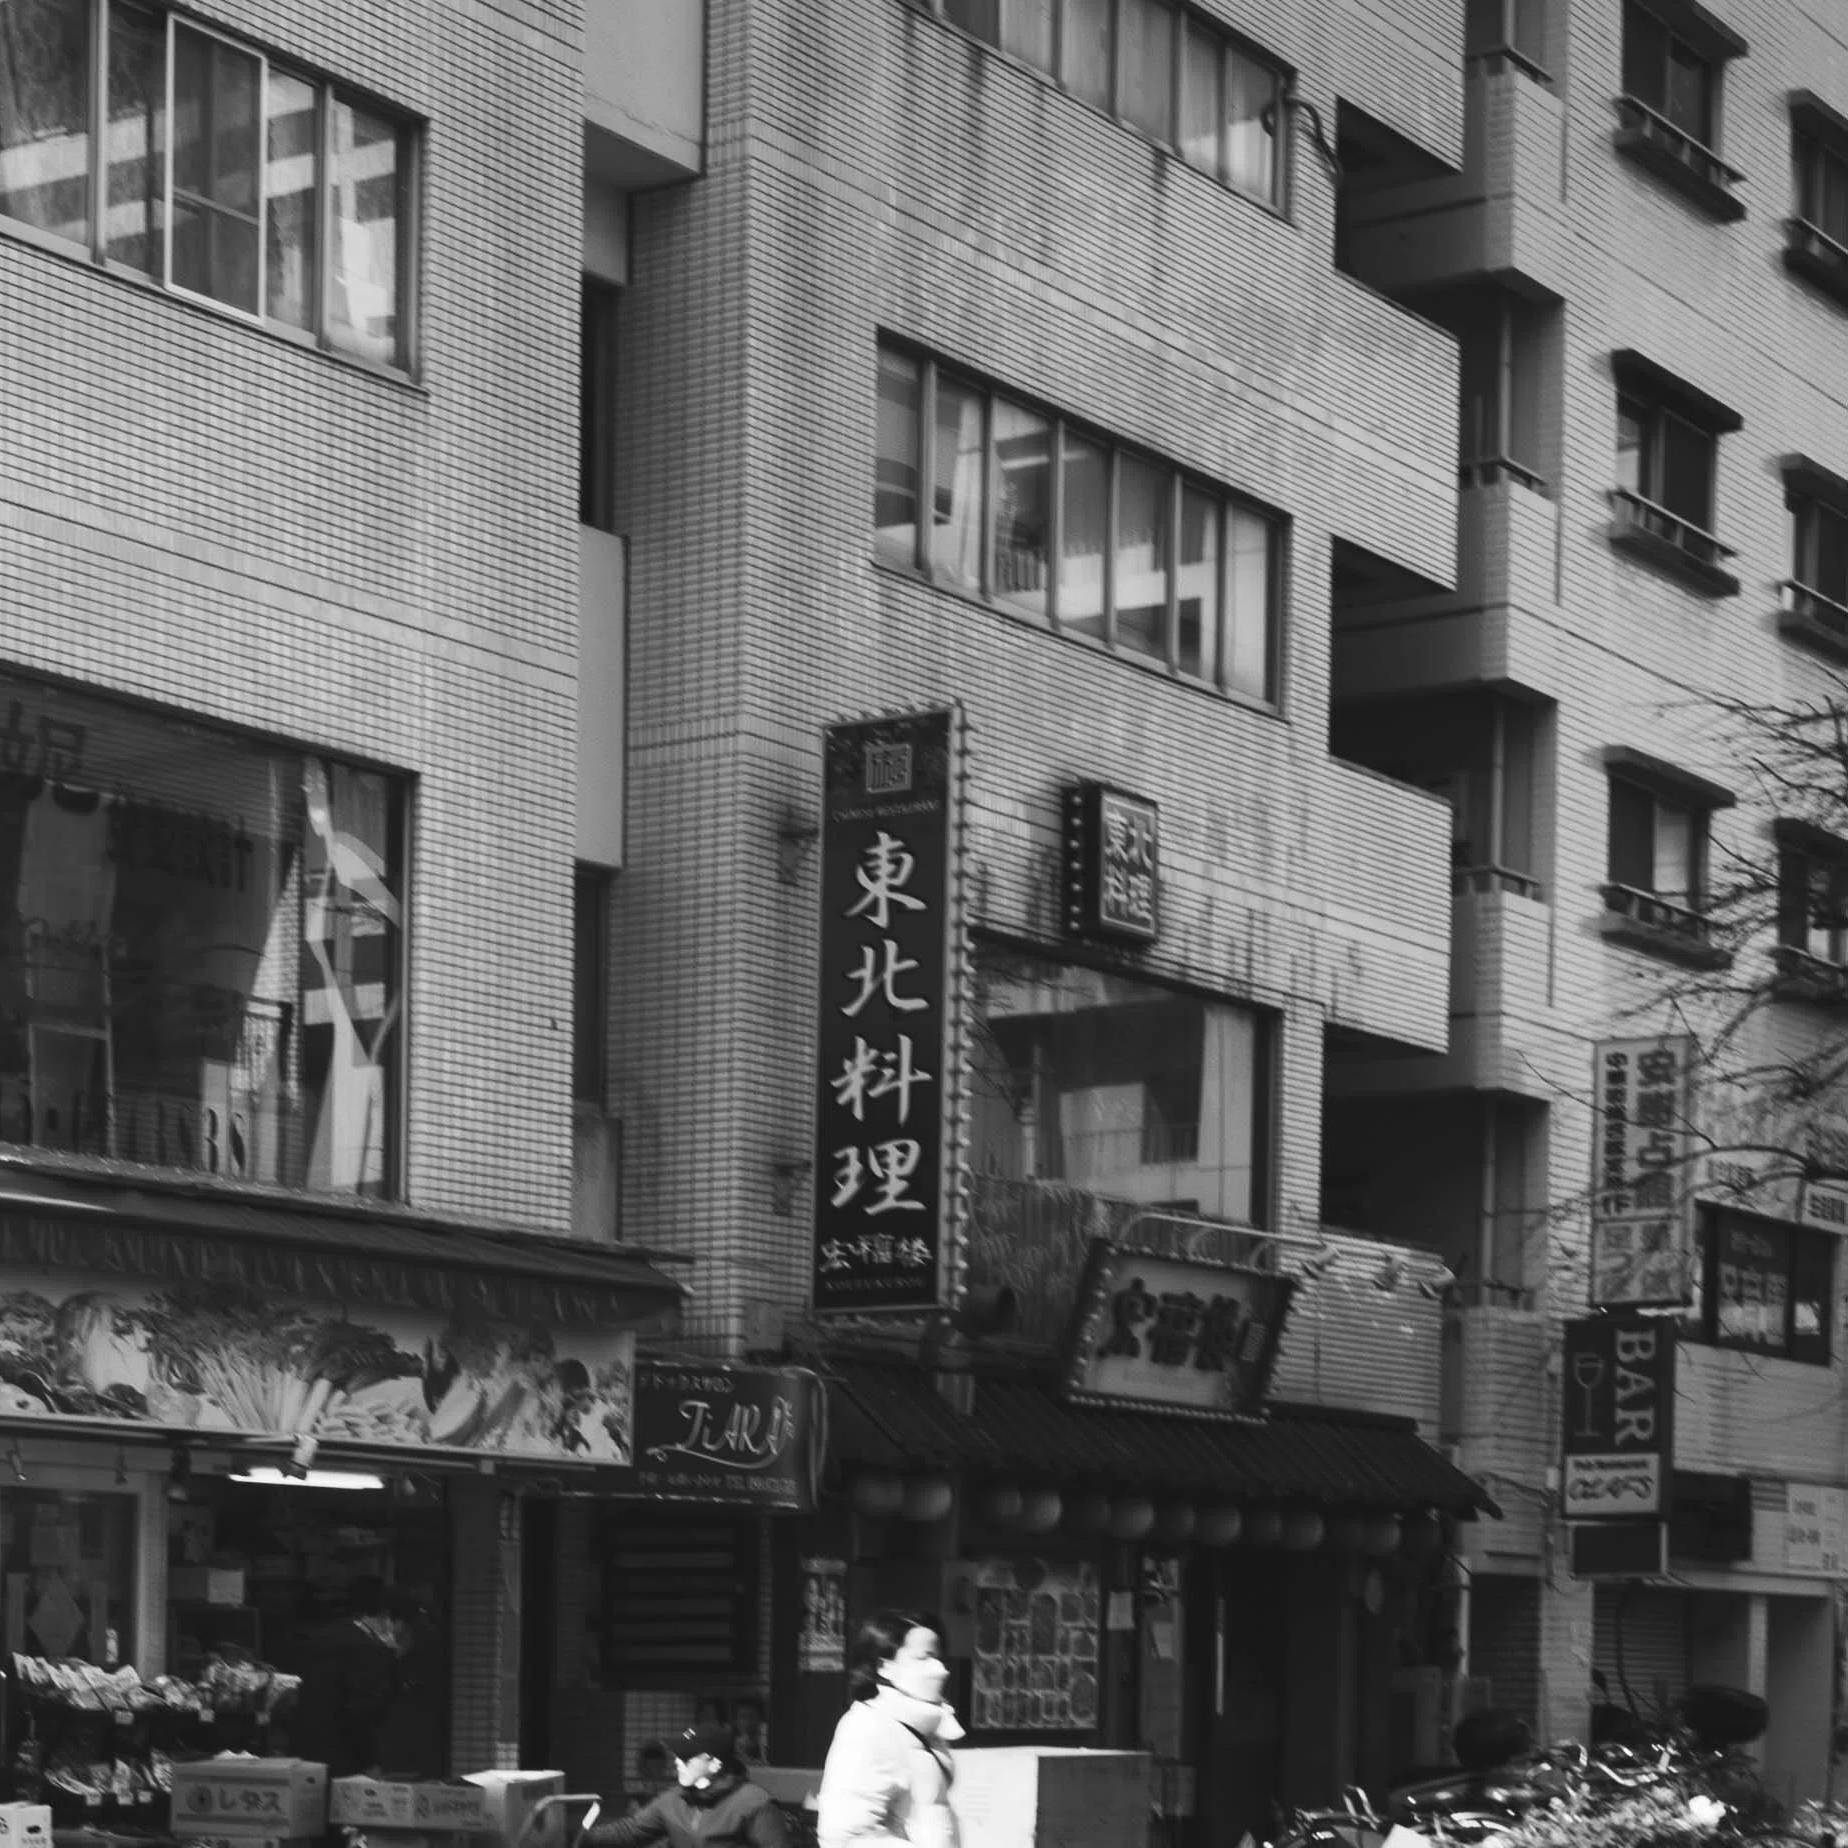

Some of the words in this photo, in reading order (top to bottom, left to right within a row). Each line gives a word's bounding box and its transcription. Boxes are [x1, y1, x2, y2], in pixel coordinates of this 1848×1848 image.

[828, 830, 933, 1217] 東北料理
[1614, 1327, 1657, 1449] BAR
